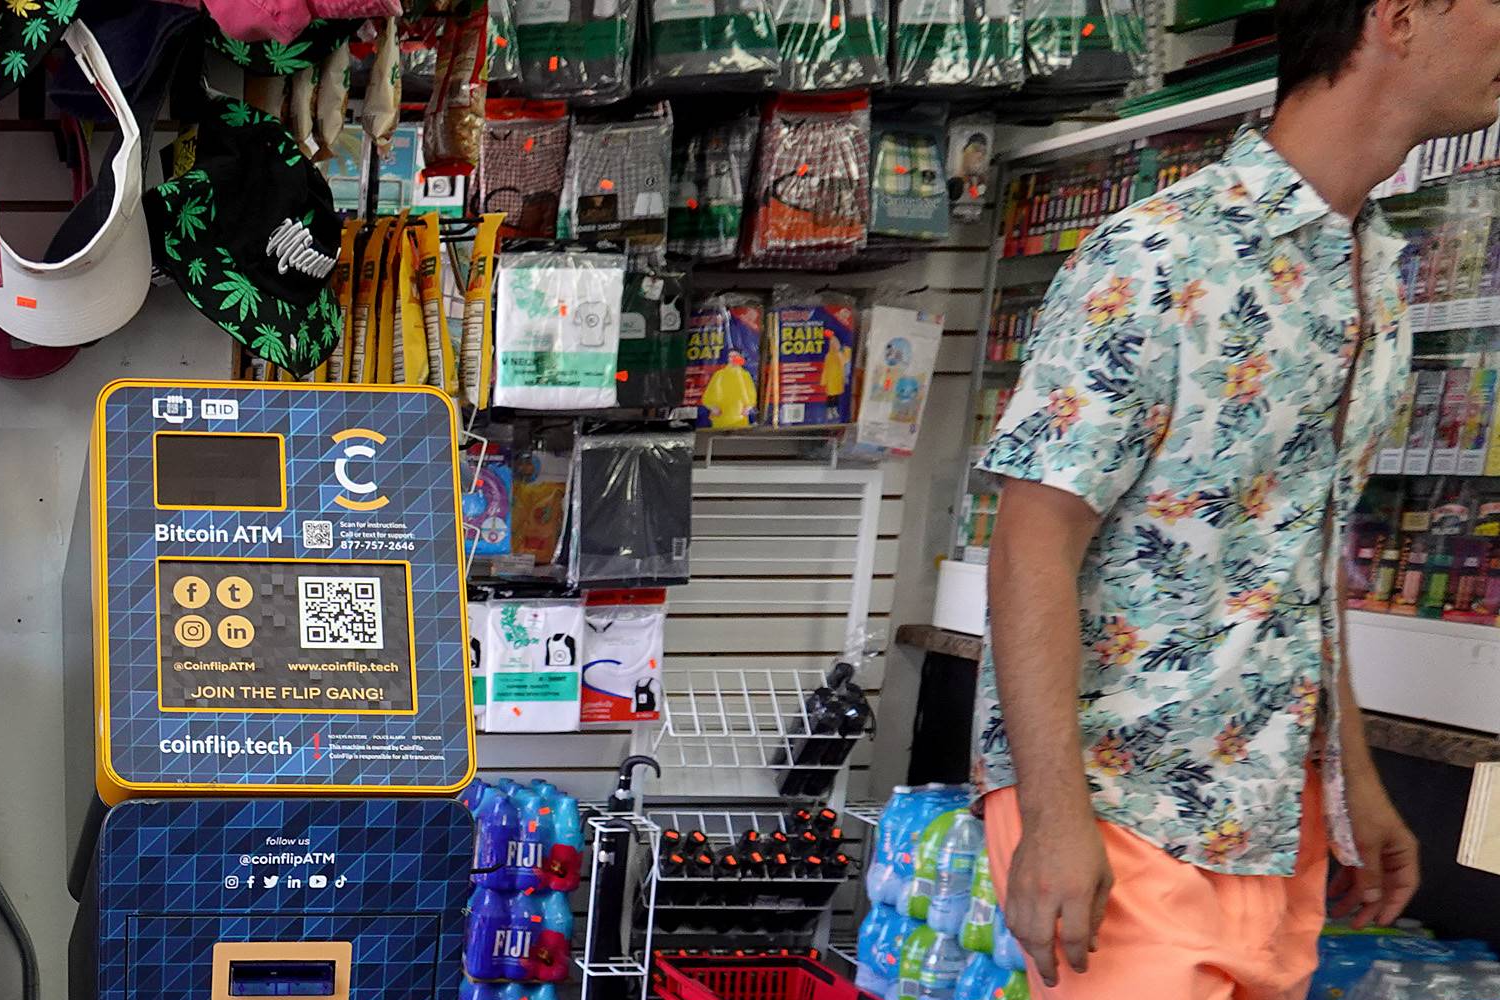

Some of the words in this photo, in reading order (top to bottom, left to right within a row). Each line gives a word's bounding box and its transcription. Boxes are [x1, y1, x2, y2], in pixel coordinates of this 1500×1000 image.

[688, 331, 724, 346] AIN
[781, 326, 825, 341] RAIN
[686, 345, 724, 361] OAT
[781, 340, 825, 355] COAT
[219, 404, 234, 416] ID
[155, 523, 229, 544] Bitcoin
[233, 525, 283, 544] ATM
[340, 540, 415, 551] 877-757-2646
[173, 661, 256, 673] @CoinflipATM
[288, 661, 399, 674] www.coinflip.tech
[191, 685, 236, 699] JOIN
[240, 686, 276, 700] THE
[281, 687, 322, 701] FLIP
[326, 687, 384, 701] GANG!
[159, 735, 293, 758] coinflip.tech
[392, 744, 398, 752] by
[329, 752, 352, 760] CoinFlip
[359, 753, 392, 761] responsible
[265, 835, 295, 846] follow
[298, 837, 310, 846] us
[239, 851, 336, 867] @coinflipATM
[507, 839, 544, 869] FIJI
[493, 929, 532, 959] FIJI
